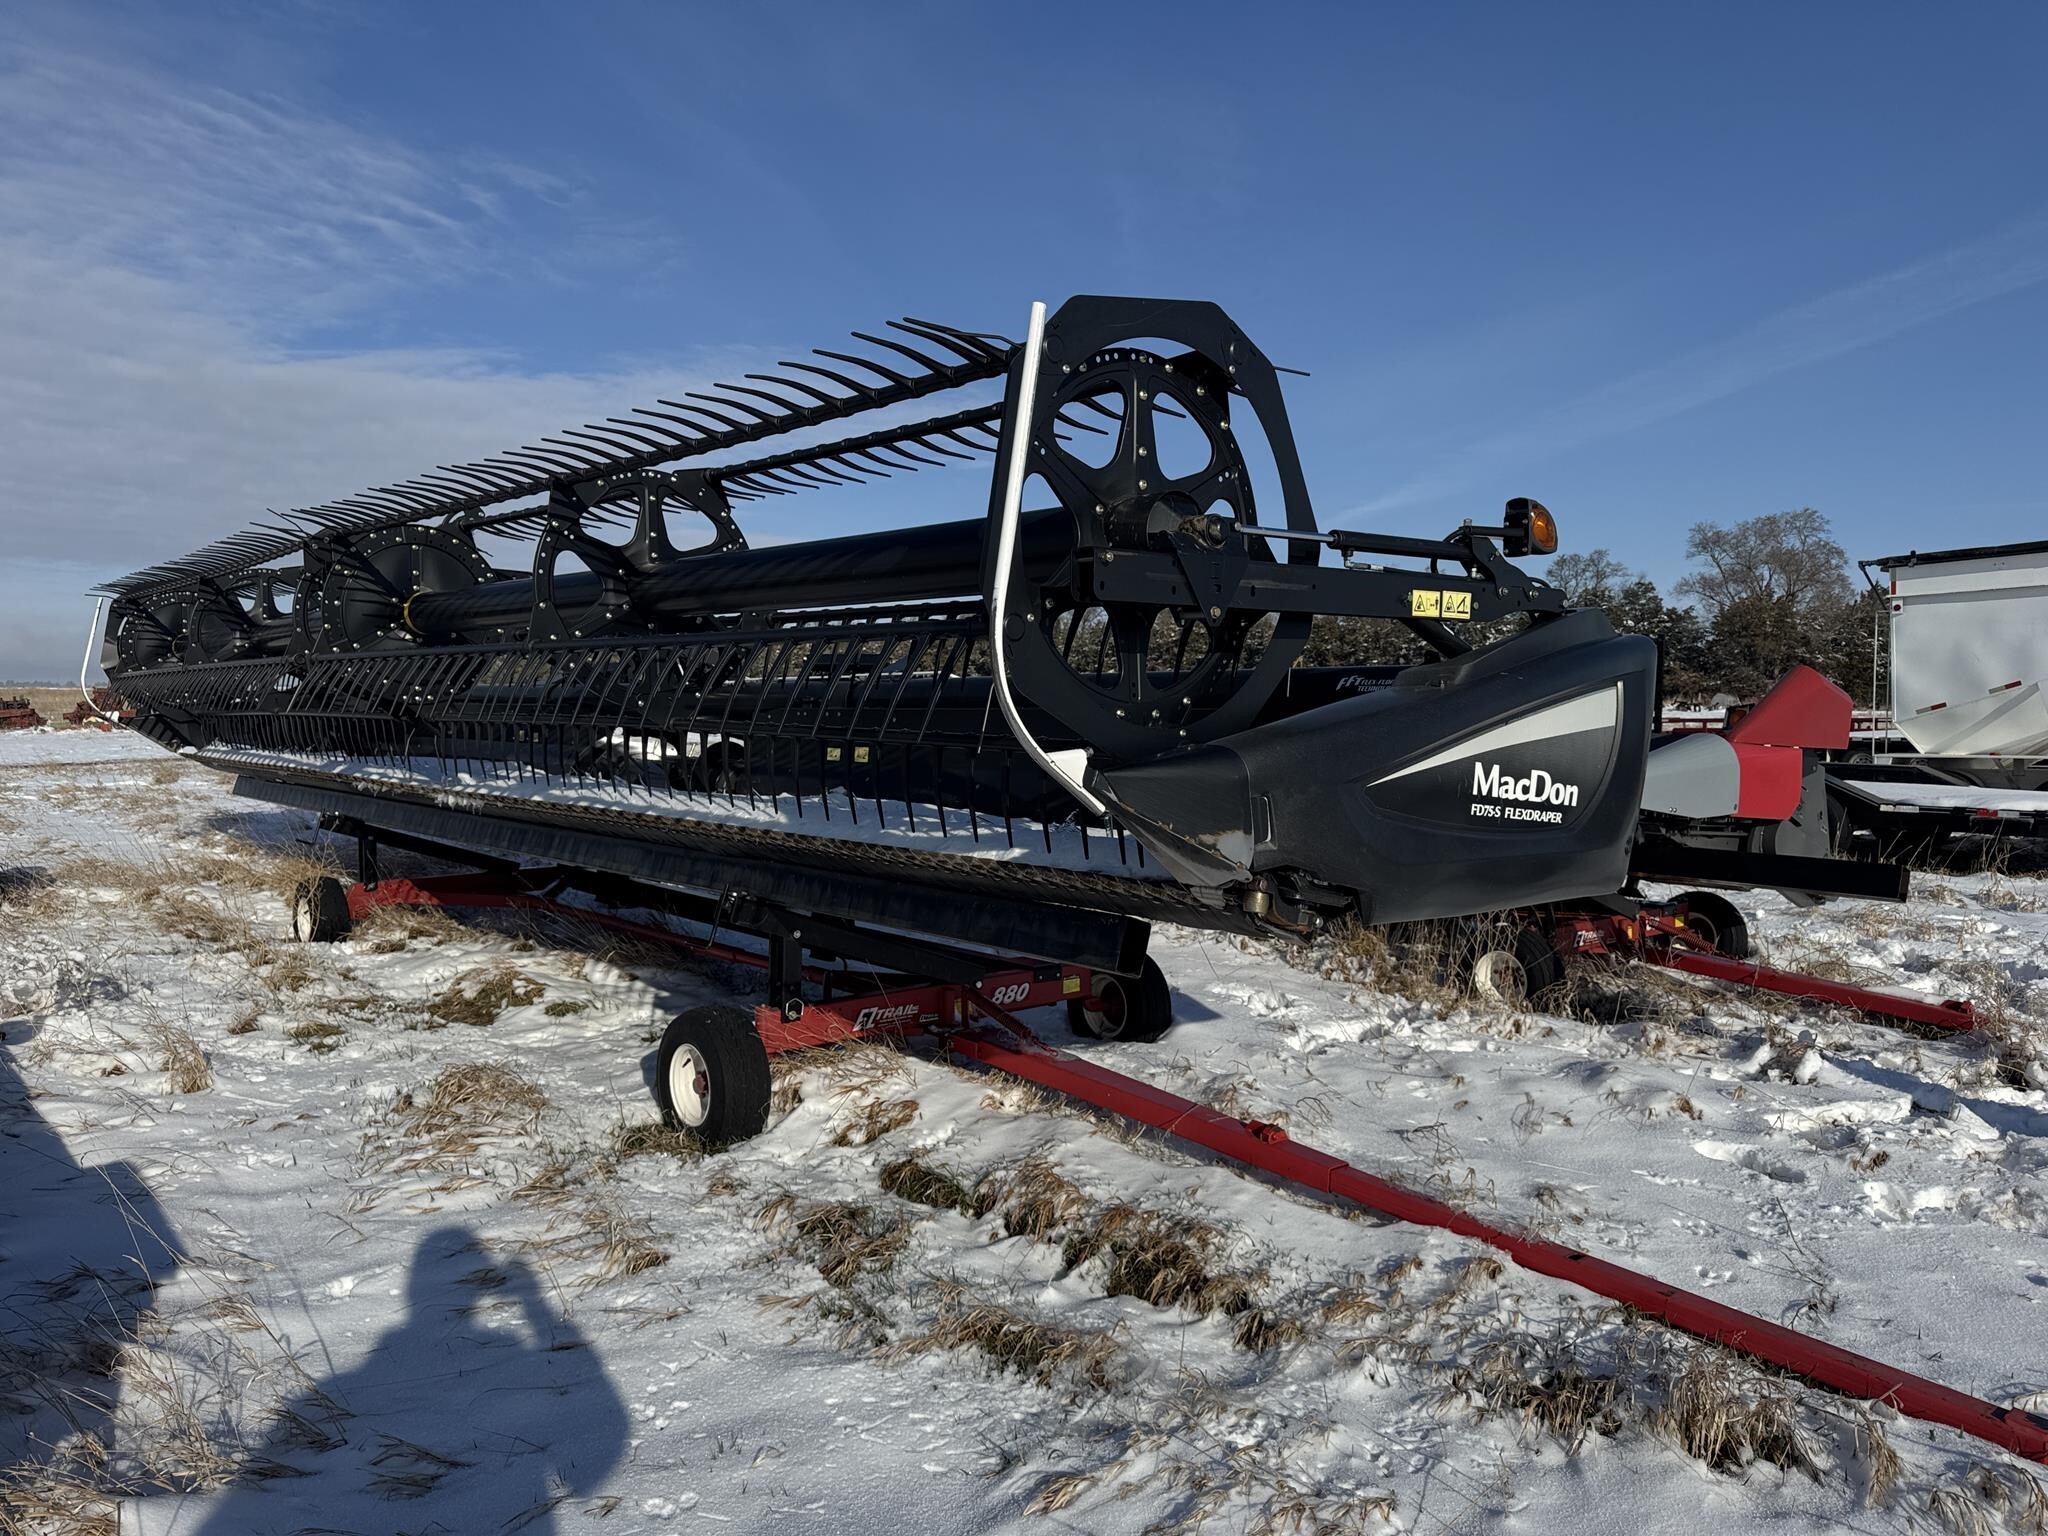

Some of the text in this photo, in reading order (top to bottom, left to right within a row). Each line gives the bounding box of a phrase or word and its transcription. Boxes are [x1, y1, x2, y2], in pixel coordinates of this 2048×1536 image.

[1472, 761, 1579, 807] MacDon
[1471, 804, 1563, 824] FD75-S FLEXDRAPER
[991, 982, 1030, 1005] 880
[876, 1003, 919, 1021] TRAIL
